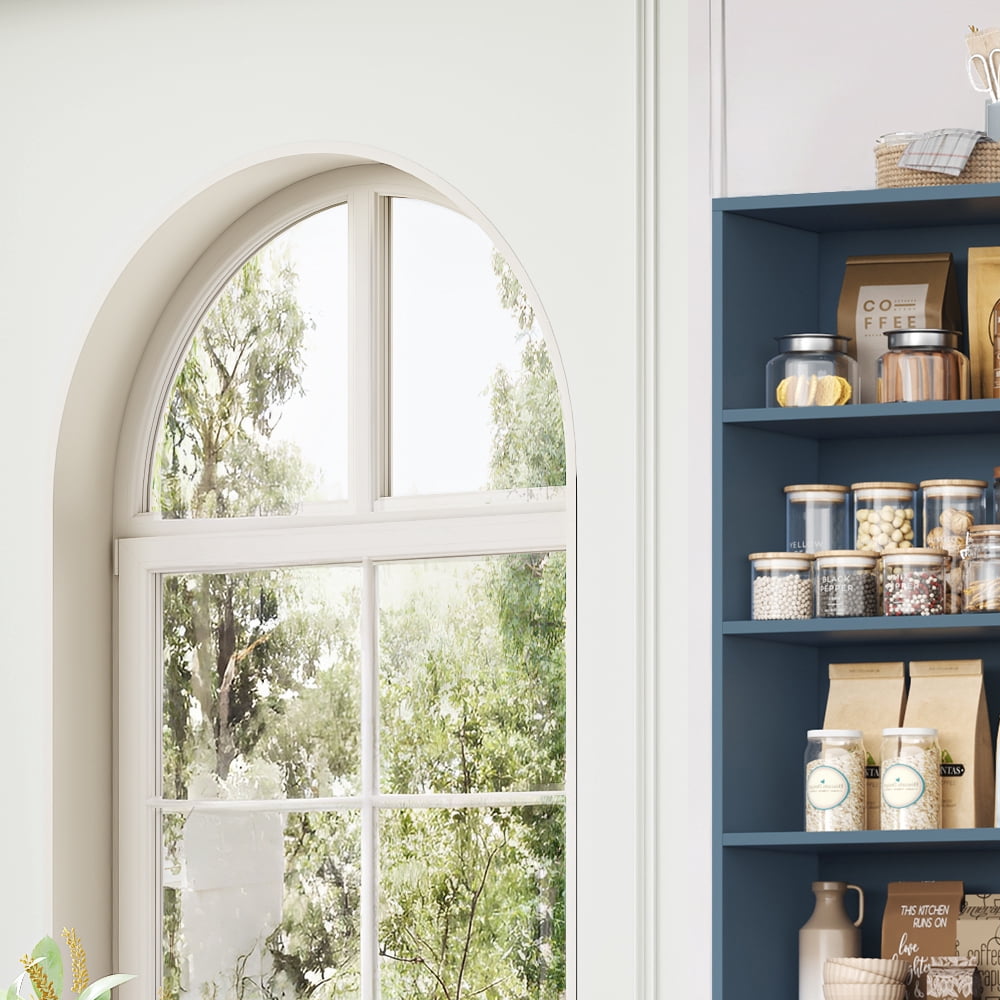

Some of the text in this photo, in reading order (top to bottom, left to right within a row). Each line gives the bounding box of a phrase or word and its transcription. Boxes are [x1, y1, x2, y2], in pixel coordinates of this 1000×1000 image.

[822, 575, 850, 583] BLACK
[820, 584, 854, 592] PEPPER
[900, 904, 950, 916] THIS KITCHEN
[912, 917, 948, 928] RUNS ON
[898, 932, 919, 956] love
